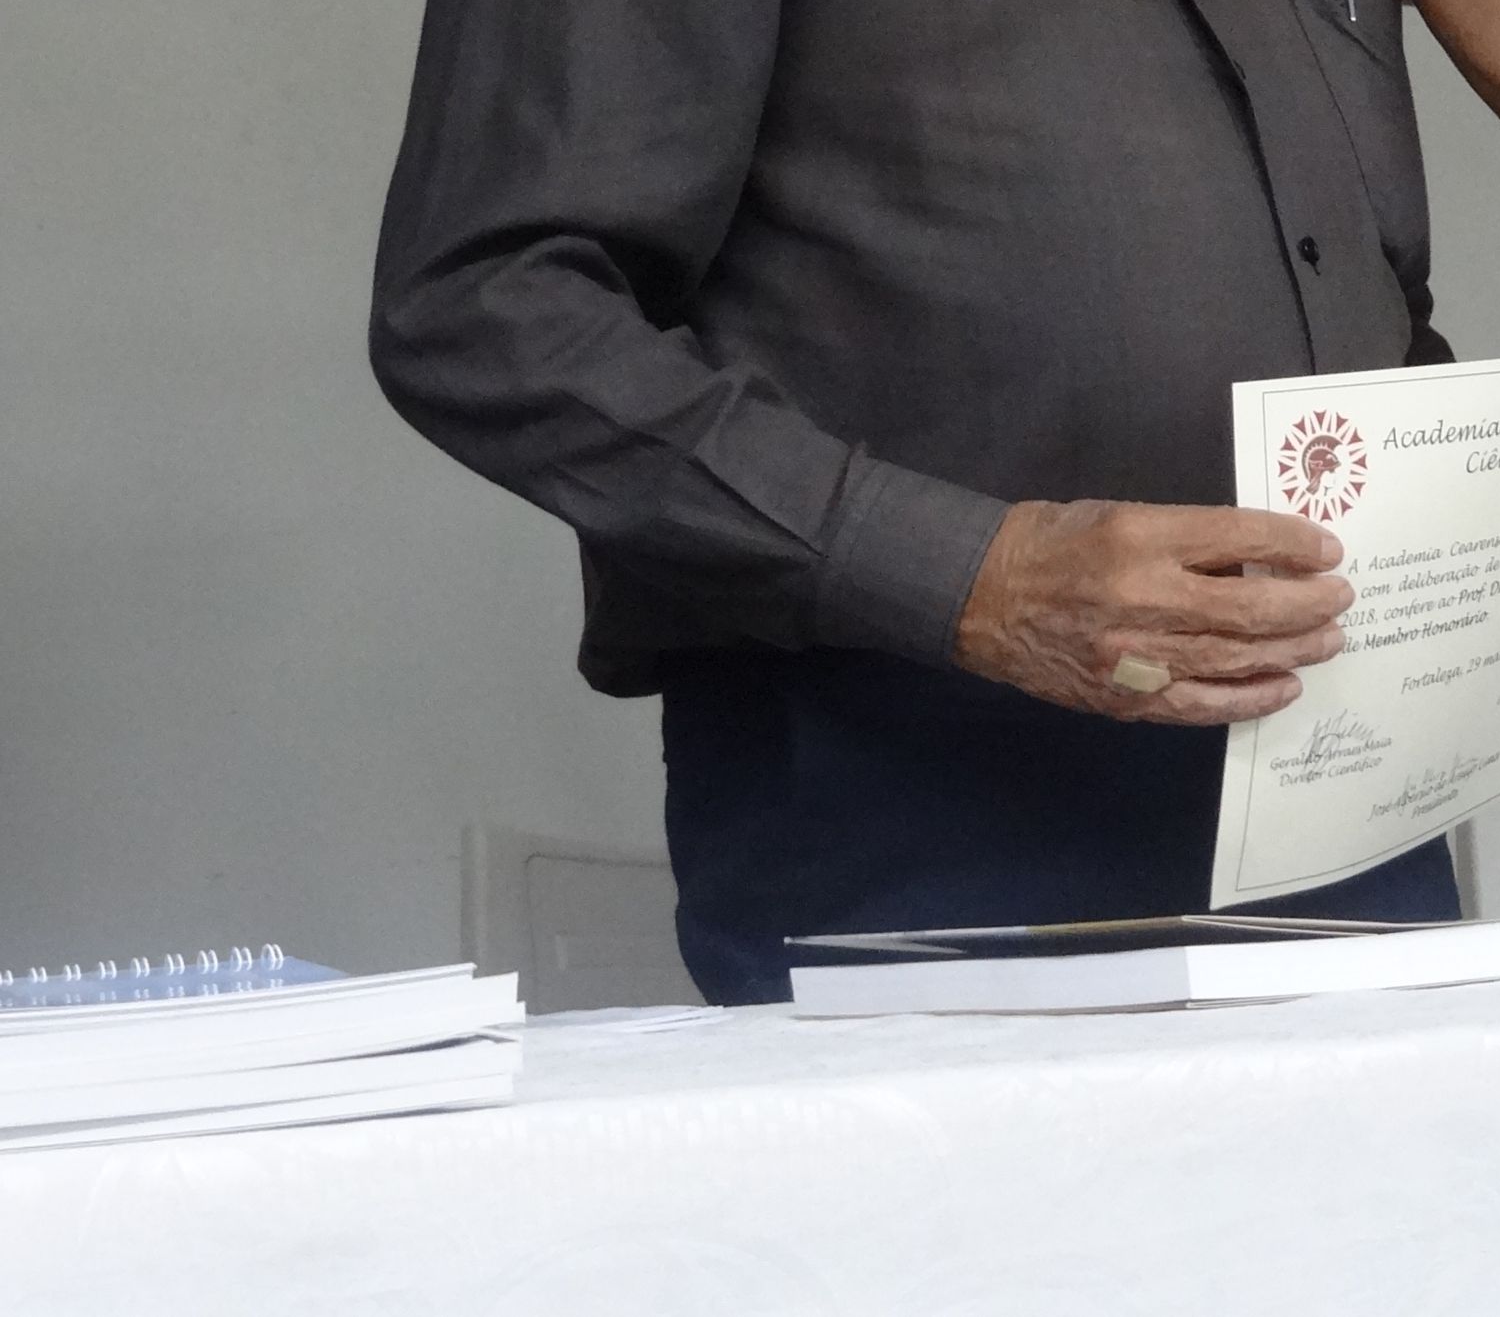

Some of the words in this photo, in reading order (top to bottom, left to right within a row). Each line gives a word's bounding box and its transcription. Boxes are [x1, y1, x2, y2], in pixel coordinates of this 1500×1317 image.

[1348, 558, 1359, 575] A
[1368, 547, 1443, 572] Academia
[1361, 583, 1392, 600] com
[1398, 564, 1481, 593] deliberação
[1485, 556, 1500, 574] de
[1339, 608, 1378, 628] 2018,
[1383, 597, 1435, 621] confere
[1456, 582, 1487, 605] Prof.
[1363, 626, 1421, 651] Membro
